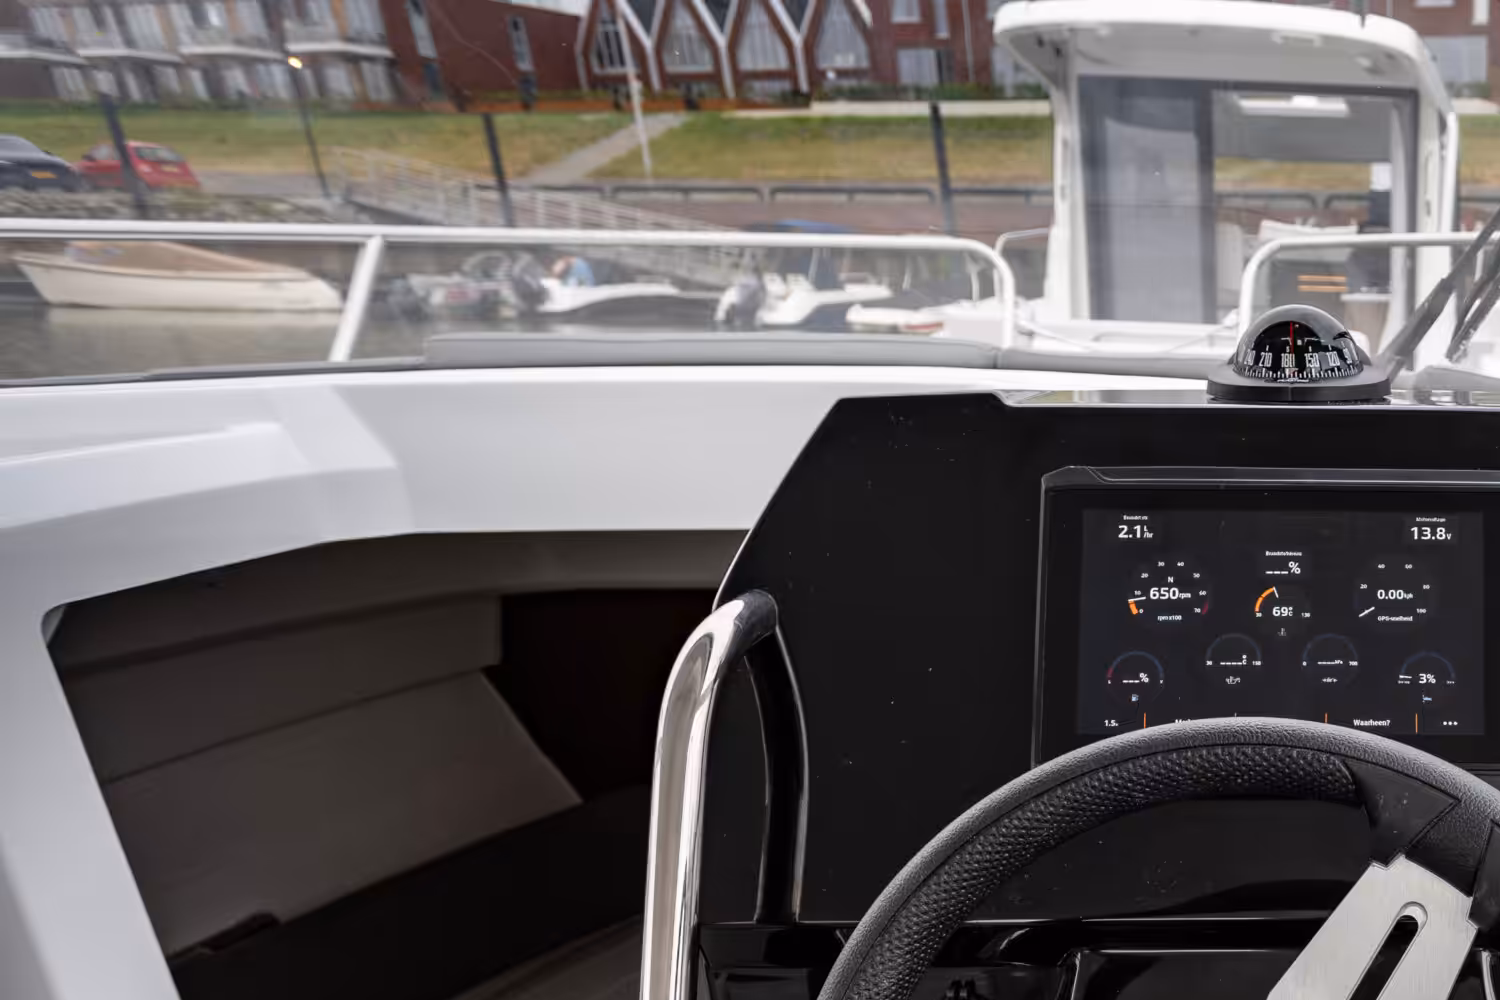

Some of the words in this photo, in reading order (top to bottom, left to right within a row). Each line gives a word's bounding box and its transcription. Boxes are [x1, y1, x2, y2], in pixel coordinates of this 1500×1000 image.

[1259, 352, 1272, 367] 210
[1281, 353, 1296, 368] 180
[1304, 352, 1320, 368] 150
[1326, 351, 1340, 366] 120
[1118, 524, 1141, 538] 2.1
[1418, 674, 1436, 684] 3%
